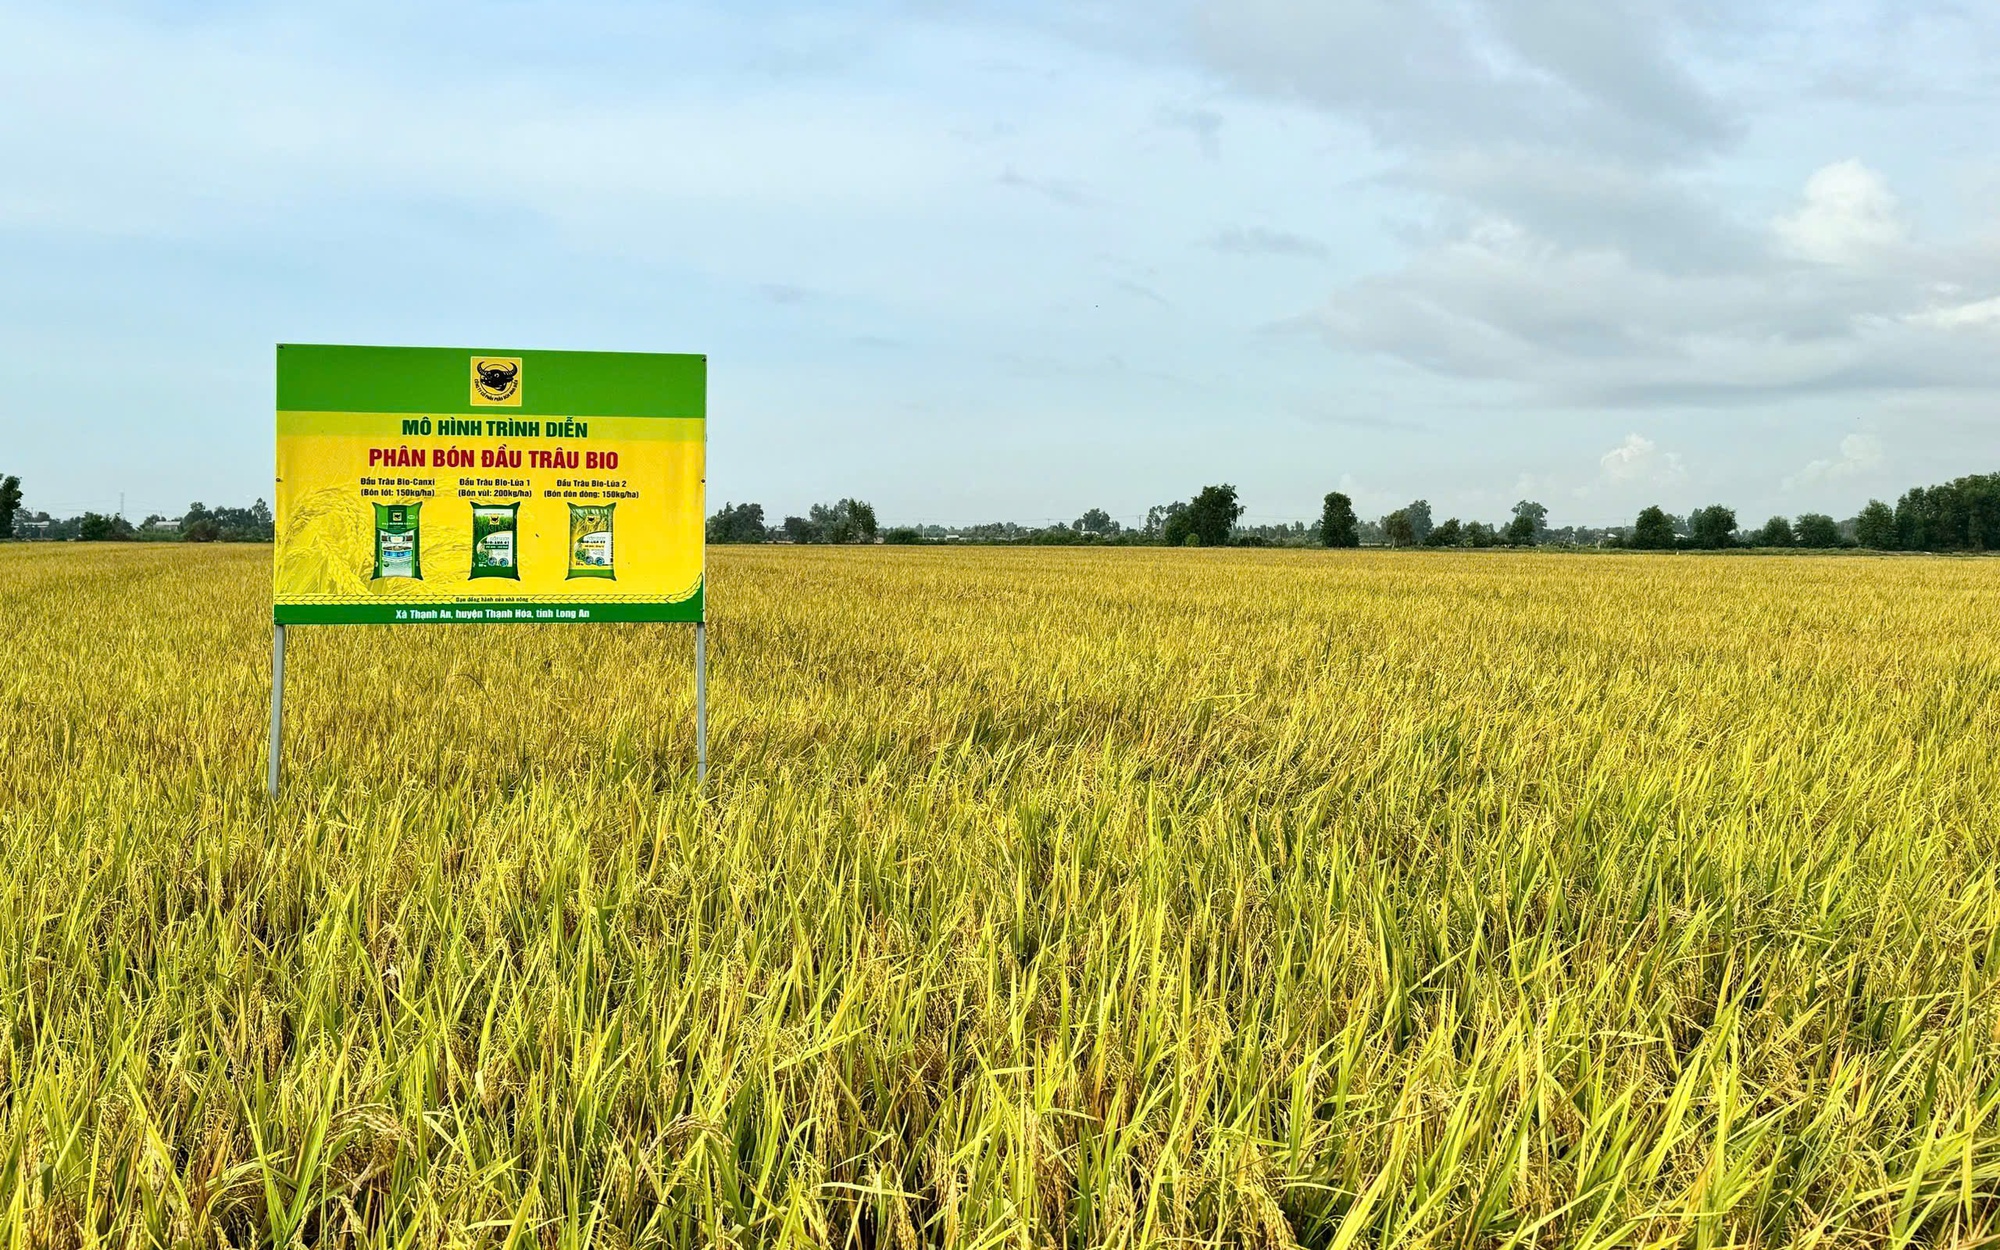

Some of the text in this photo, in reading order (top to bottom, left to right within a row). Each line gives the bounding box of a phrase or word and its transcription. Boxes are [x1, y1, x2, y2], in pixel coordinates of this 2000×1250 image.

[402, 416, 588, 438] MÔ HÌNH TRÌNH DIỄN
[369, 444, 619, 469] PHÂN BÓN ĐẦU TRÂU BIO
[396, 489, 435, 497] 150kg/ha)
[410, 610, 437, 620] Thạnh
[440, 610, 453, 619] An,
[456, 609, 482, 620] huyện
[485, 609, 512, 619] Thạnh
[515, 609, 533, 618] Hóa,
[556, 609, 576, 619] Long
[579, 609, 589, 618] An
